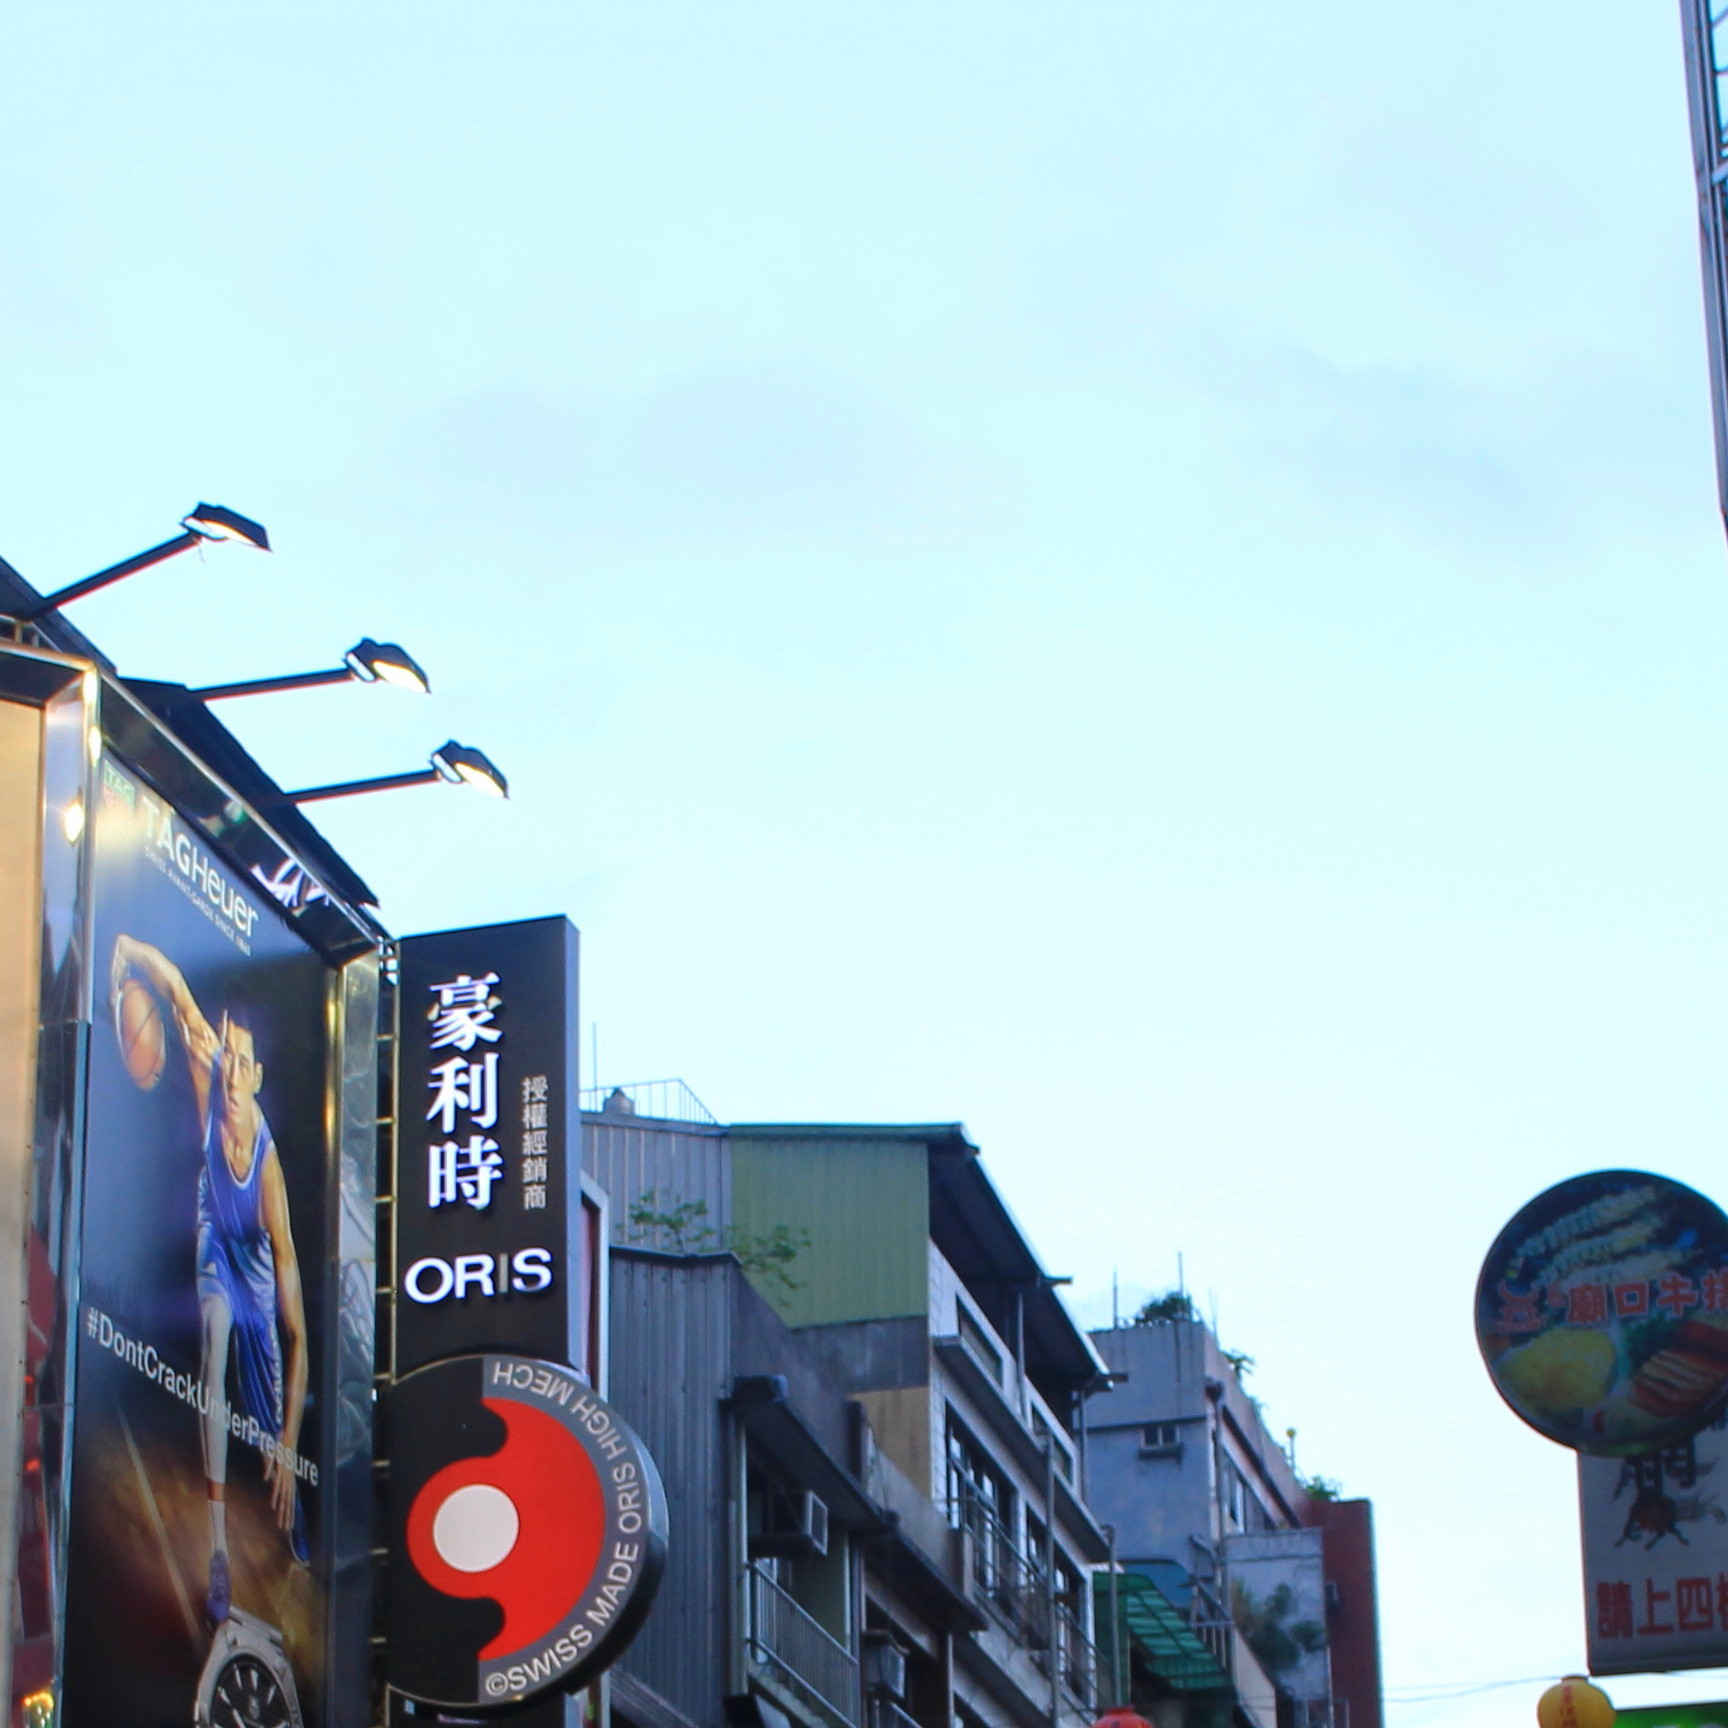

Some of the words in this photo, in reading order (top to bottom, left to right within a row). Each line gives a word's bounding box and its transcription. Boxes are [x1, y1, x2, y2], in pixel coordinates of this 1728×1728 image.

[425, 971, 504, 1212] 豪利時
[521, 1075, 549, 1211] 授權經銷商
[403, 1247, 554, 1305] ORIS
[491, 1361, 575, 1407] MECH
[569, 1392, 629, 1458] HIGH
[612, 1459, 643, 1534] ORIS
[586, 1542, 641, 1628] MADE
